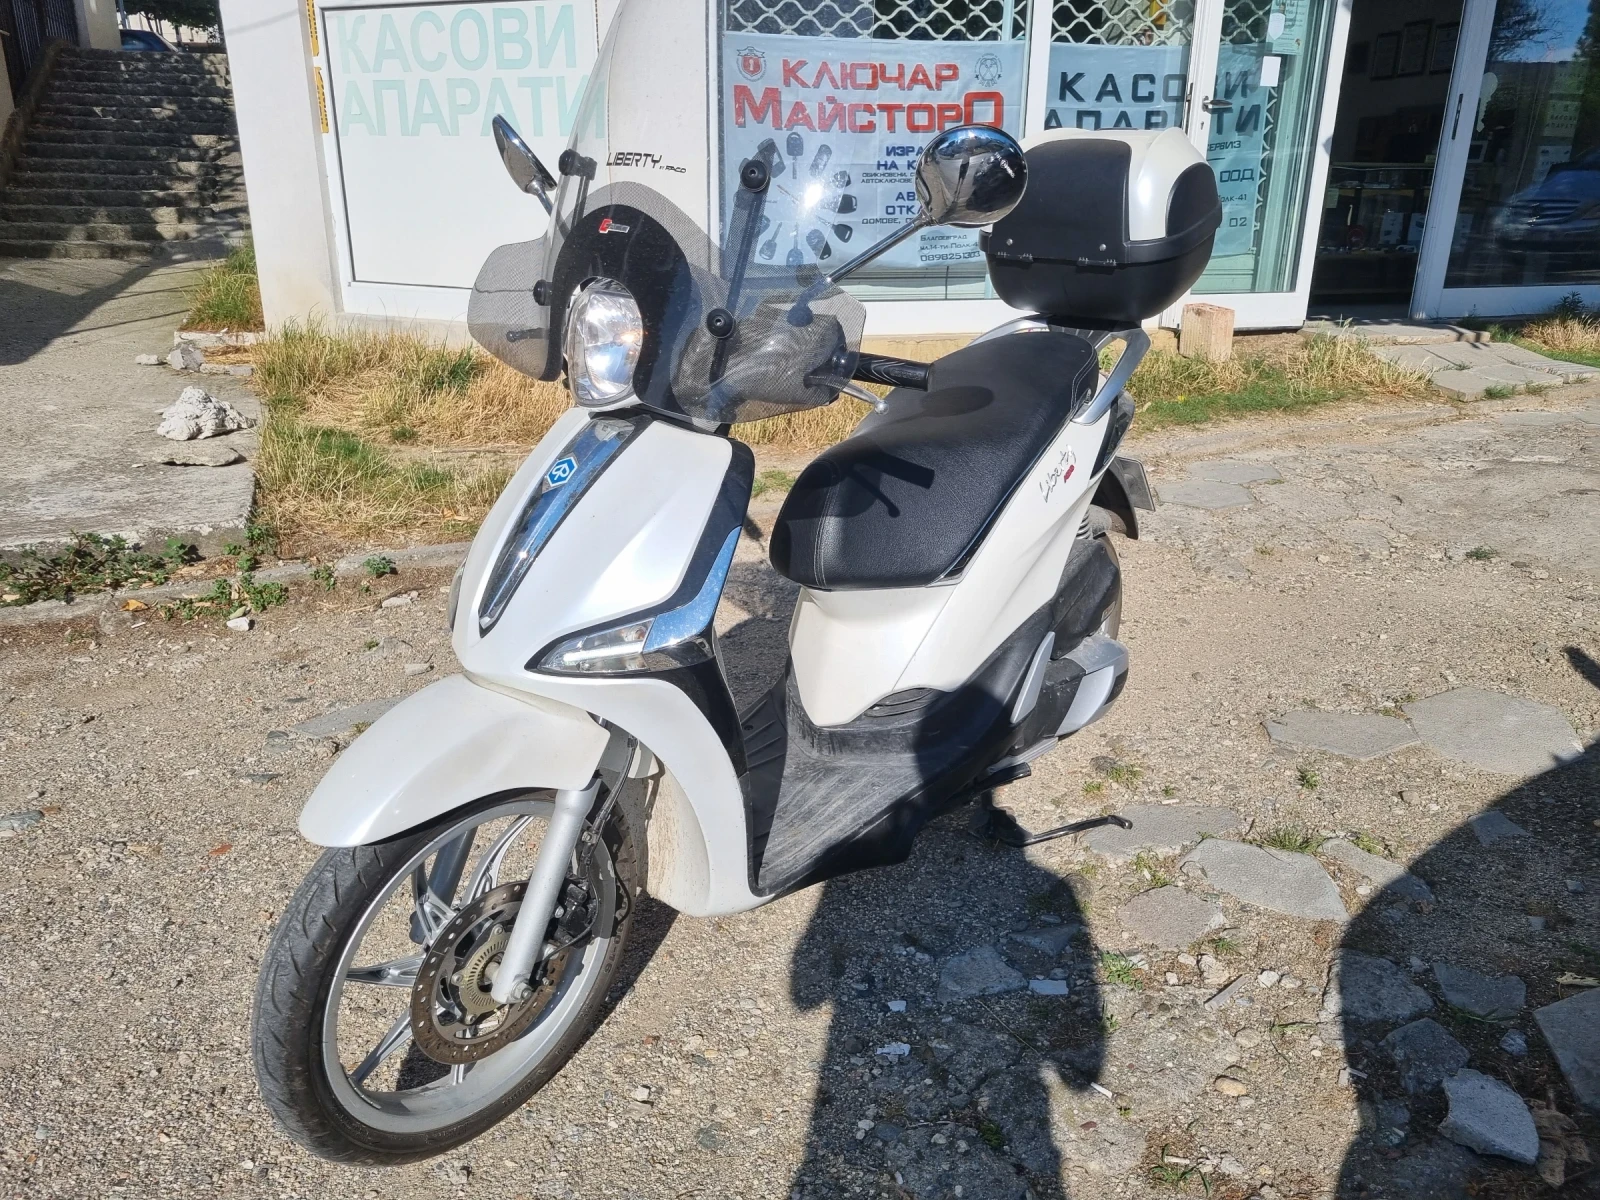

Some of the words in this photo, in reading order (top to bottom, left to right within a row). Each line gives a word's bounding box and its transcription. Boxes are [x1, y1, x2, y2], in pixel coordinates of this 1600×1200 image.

[336, 4, 577, 74] КАСОВИ
[782, 58, 959, 91] КЛЮЧАР
[1058, 71, 1249, 103] КАСОИ
[340, 74, 606, 141] АПАРАТИ
[1044, 104, 1261, 135] АПАРТИ
[885, 145, 925, 157] ИЗРА
[606, 152, 662, 169] LIBERTY
[877, 160, 899, 170] НА
[1220, 169, 1254, 183] ООД
[895, 191, 915, 201] АВ
[885, 205, 921, 215] ОТК
